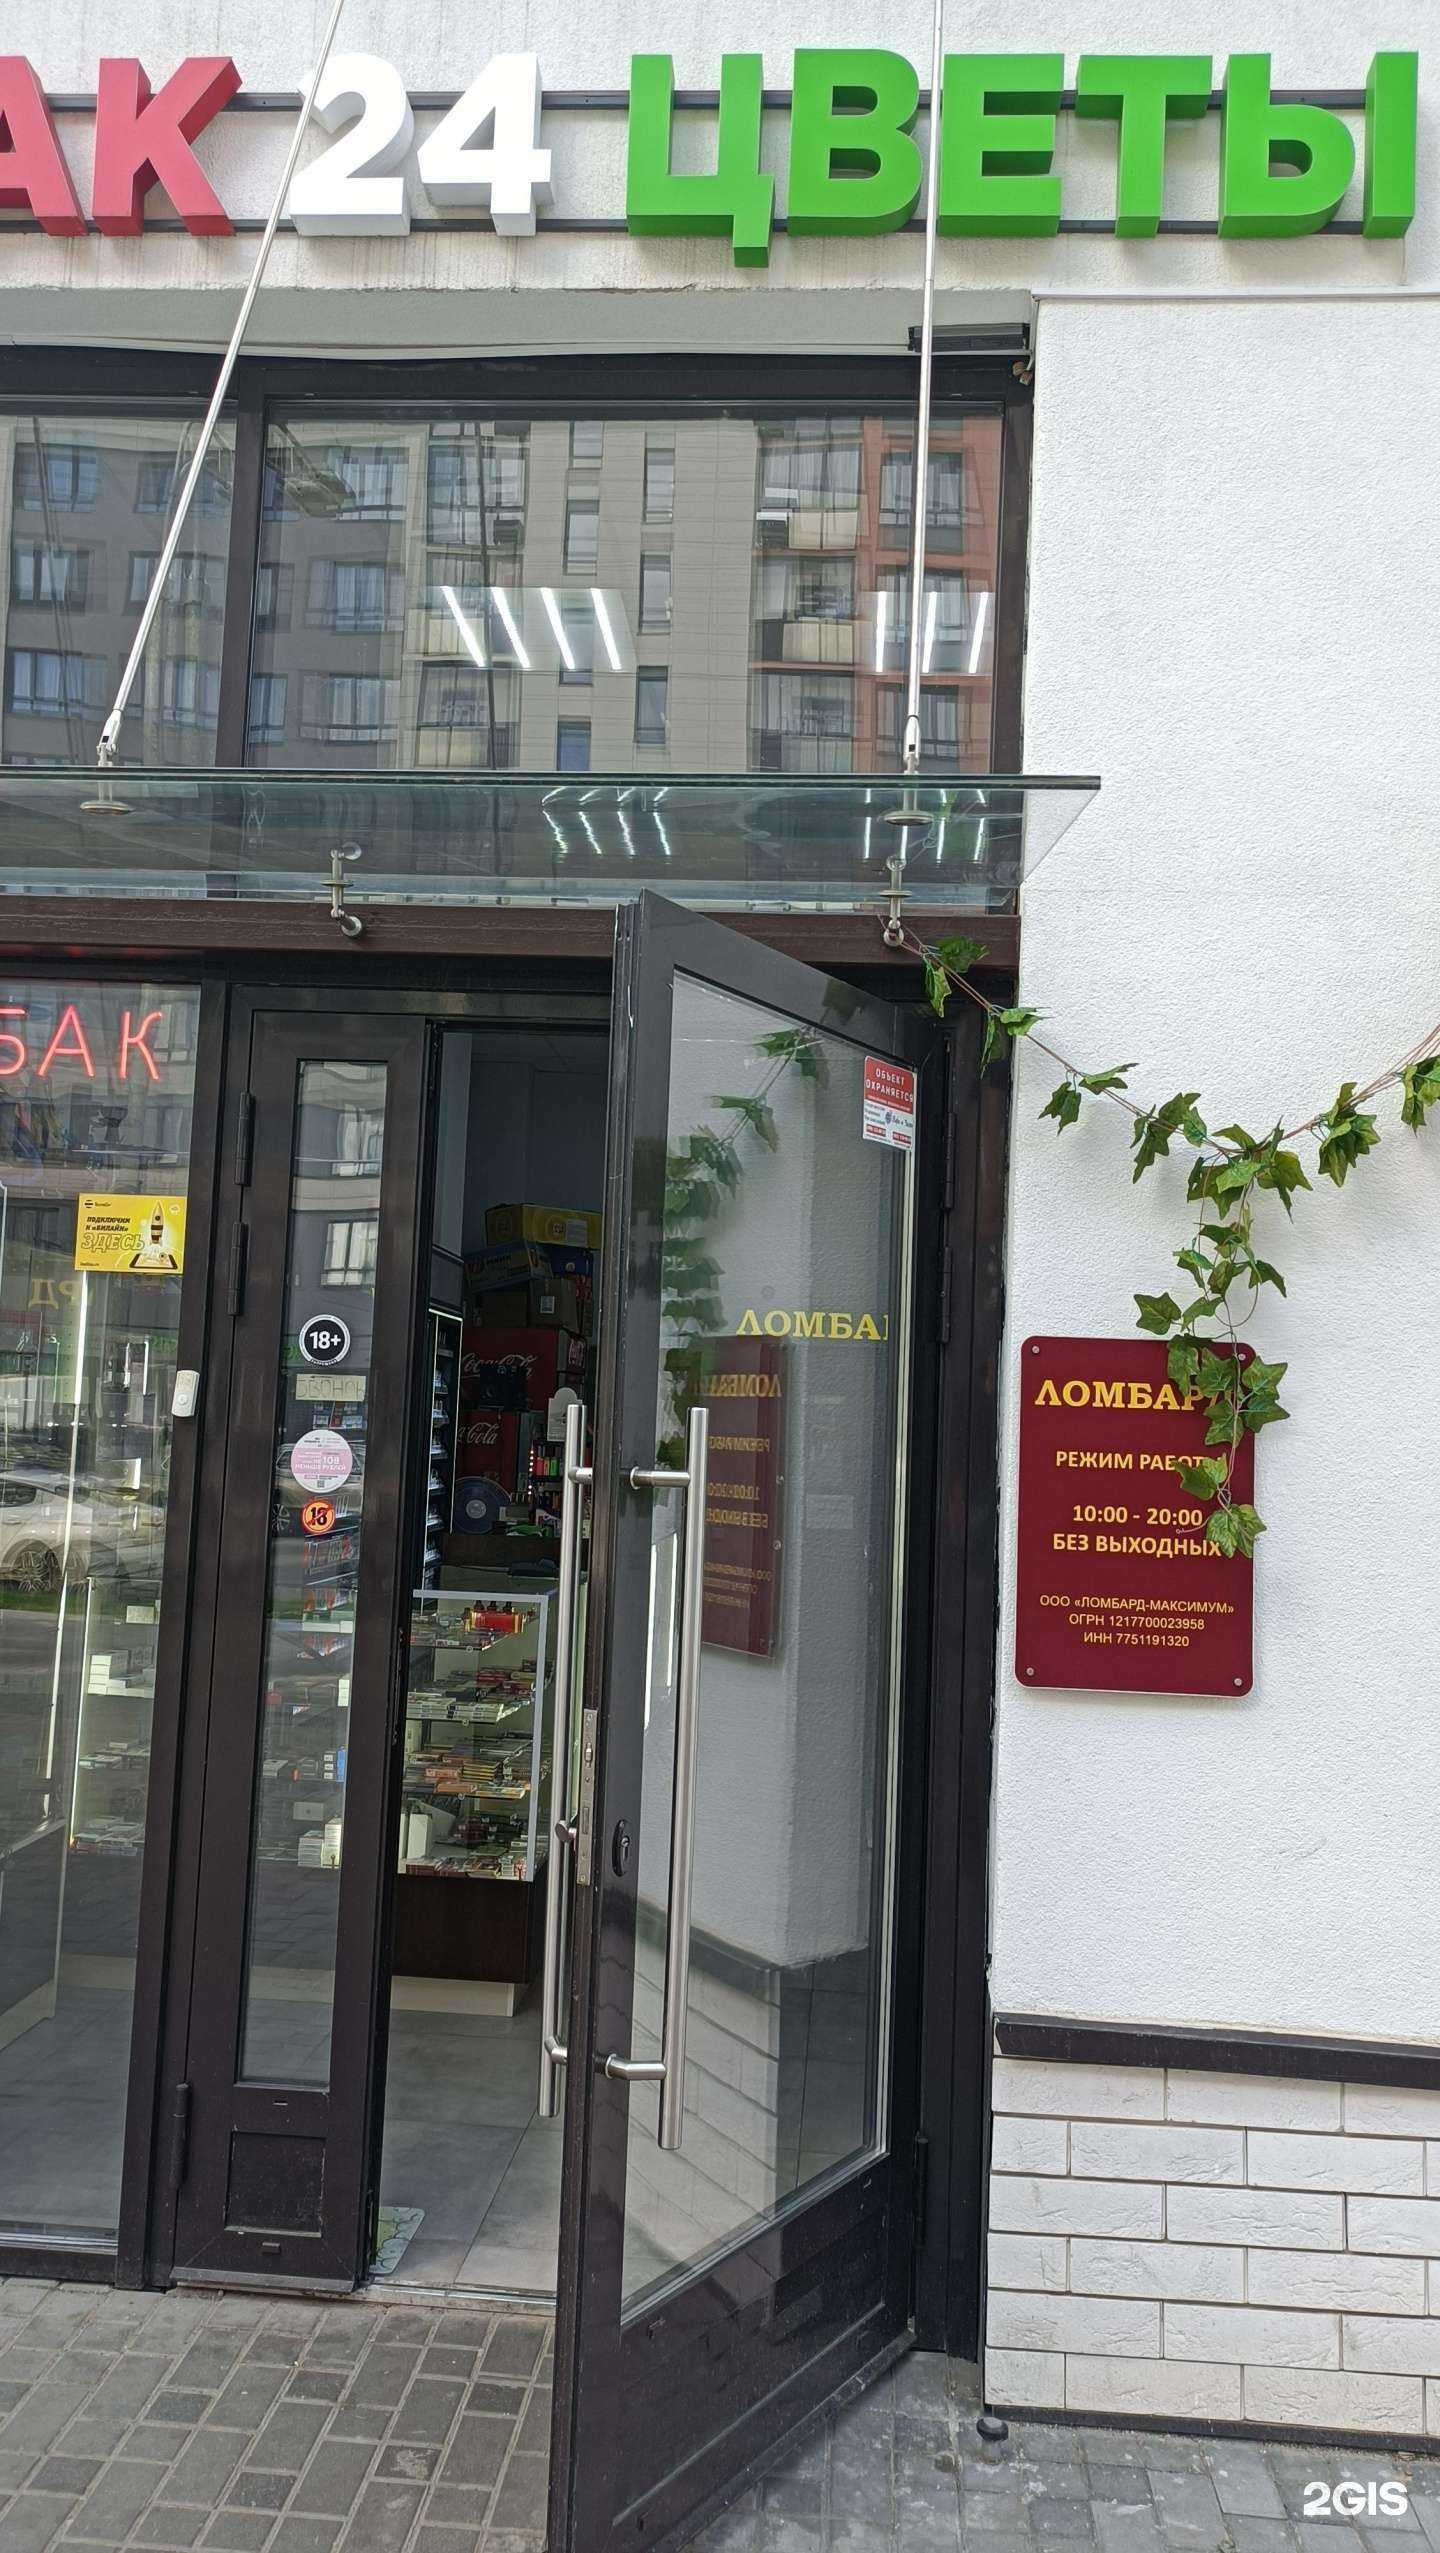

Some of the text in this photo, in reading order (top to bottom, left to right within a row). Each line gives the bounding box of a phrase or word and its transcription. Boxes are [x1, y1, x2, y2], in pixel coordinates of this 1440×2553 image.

[288, 53, 553, 236] 24
[626, 48, 1419, 268] ЦВЕТЫ
[81, 1233, 146, 1253] ЗДЕСЬ
[309, 1331, 341, 1349] 18+
[1034, 1379, 1233, 1411] ЛОМБАР
[1056, 1451, 1220, 1471] РЕЖИМ РАБОТ
[1073, 1505, 1128, 1523] 10:00
[1146, 1507, 1203, 1526] 20:00
[1053, 1533, 1222, 1558] БЕЗ ВЫХОДНЫХ
[1039, 1595, 1234, 1614] ООО «ЛОМБАРД-МАКСИМУМ»
[1069, 1614, 1205, 1630] ОГРН 1217700023958
[1084, 1632, 1190, 1647] ИНН 7751191320
